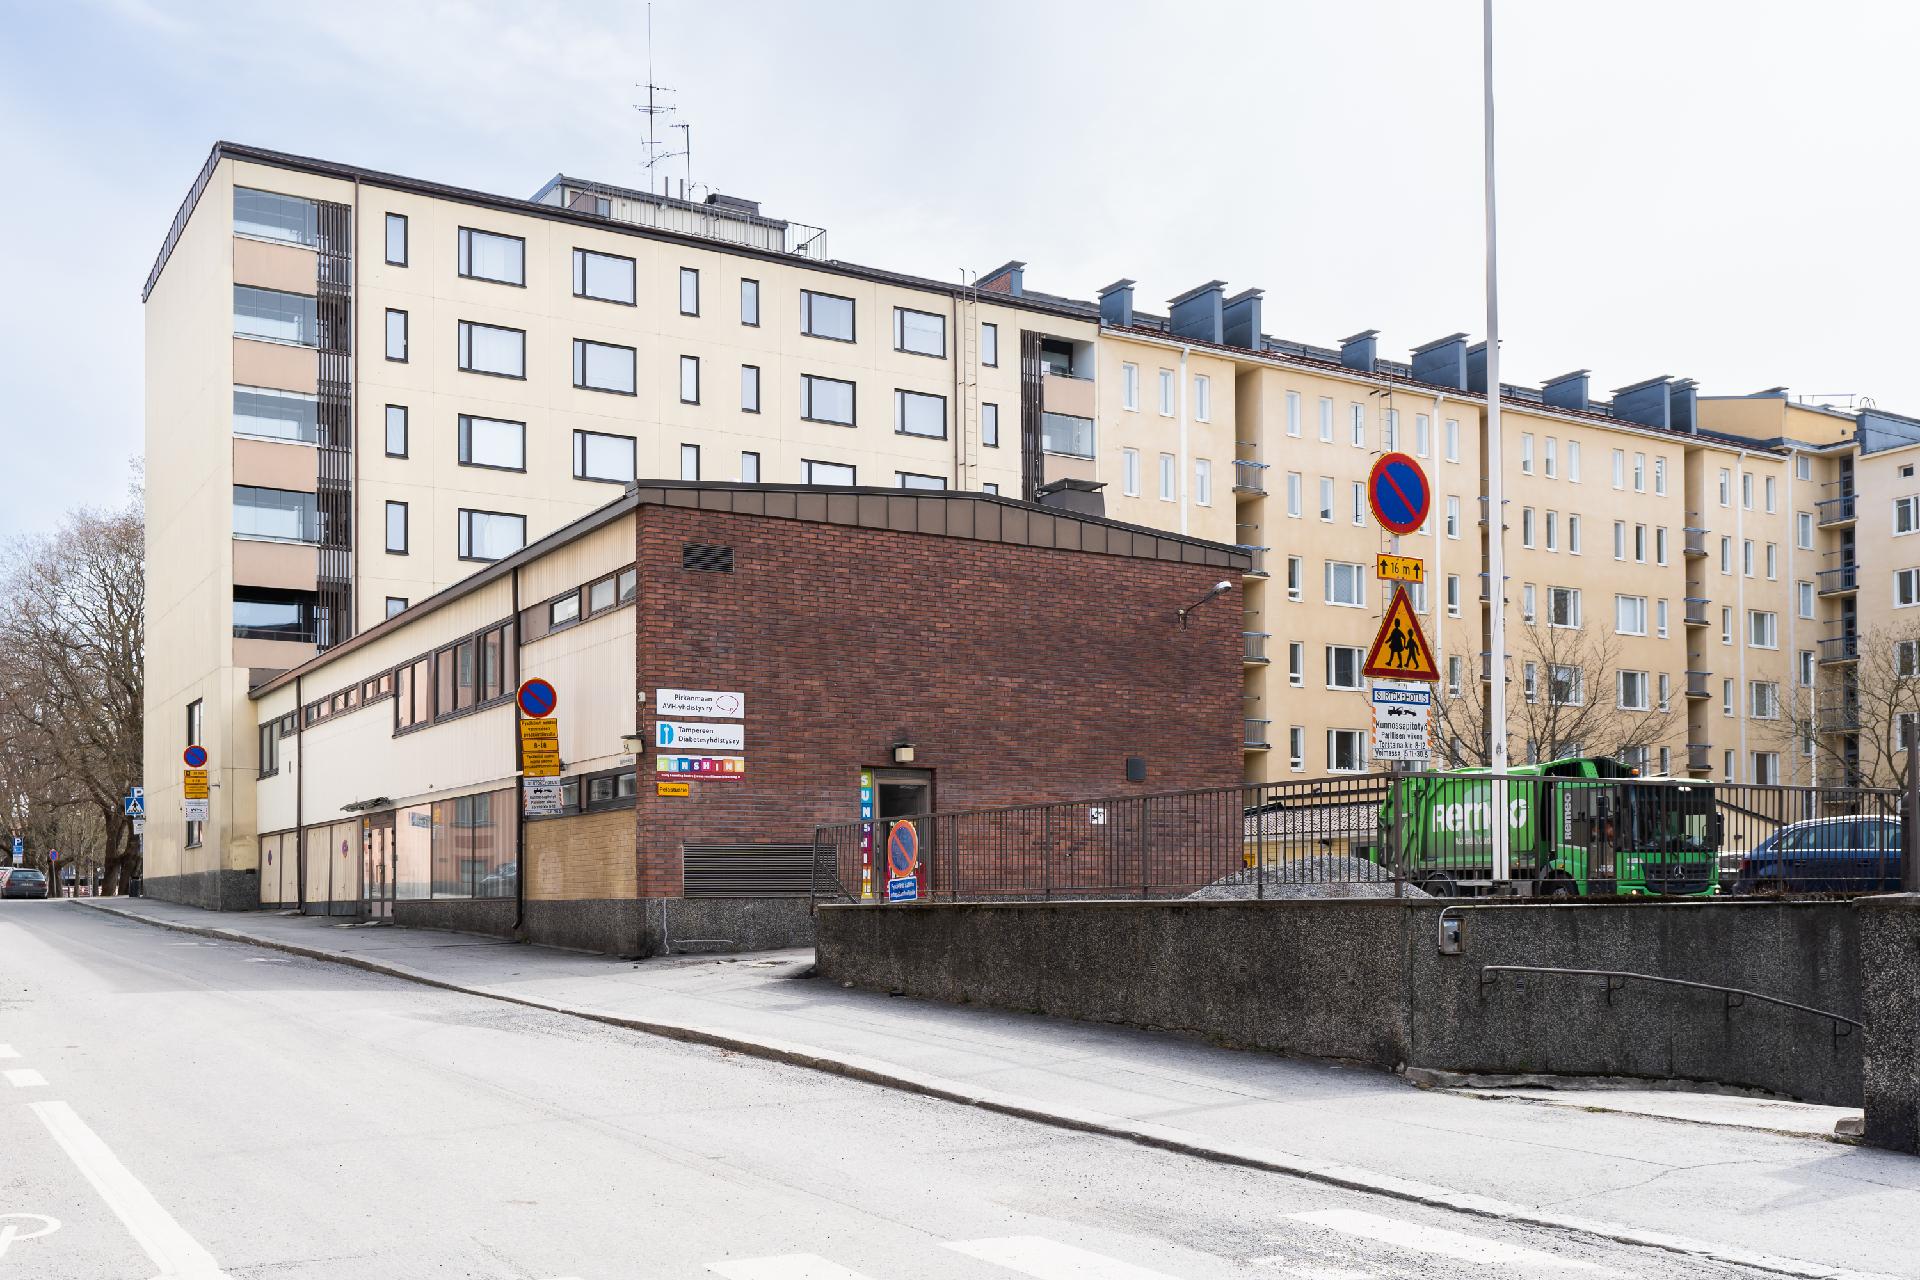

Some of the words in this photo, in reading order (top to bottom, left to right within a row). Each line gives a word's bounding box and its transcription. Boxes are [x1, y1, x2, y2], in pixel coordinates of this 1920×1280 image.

[1391, 562, 1399, 573] 16
[1403, 566, 1410, 575] m
[674, 694, 713, 702] Pirkanmaan
[678, 726, 714, 734] Tampereen
[14, 838, 22, 846] P
